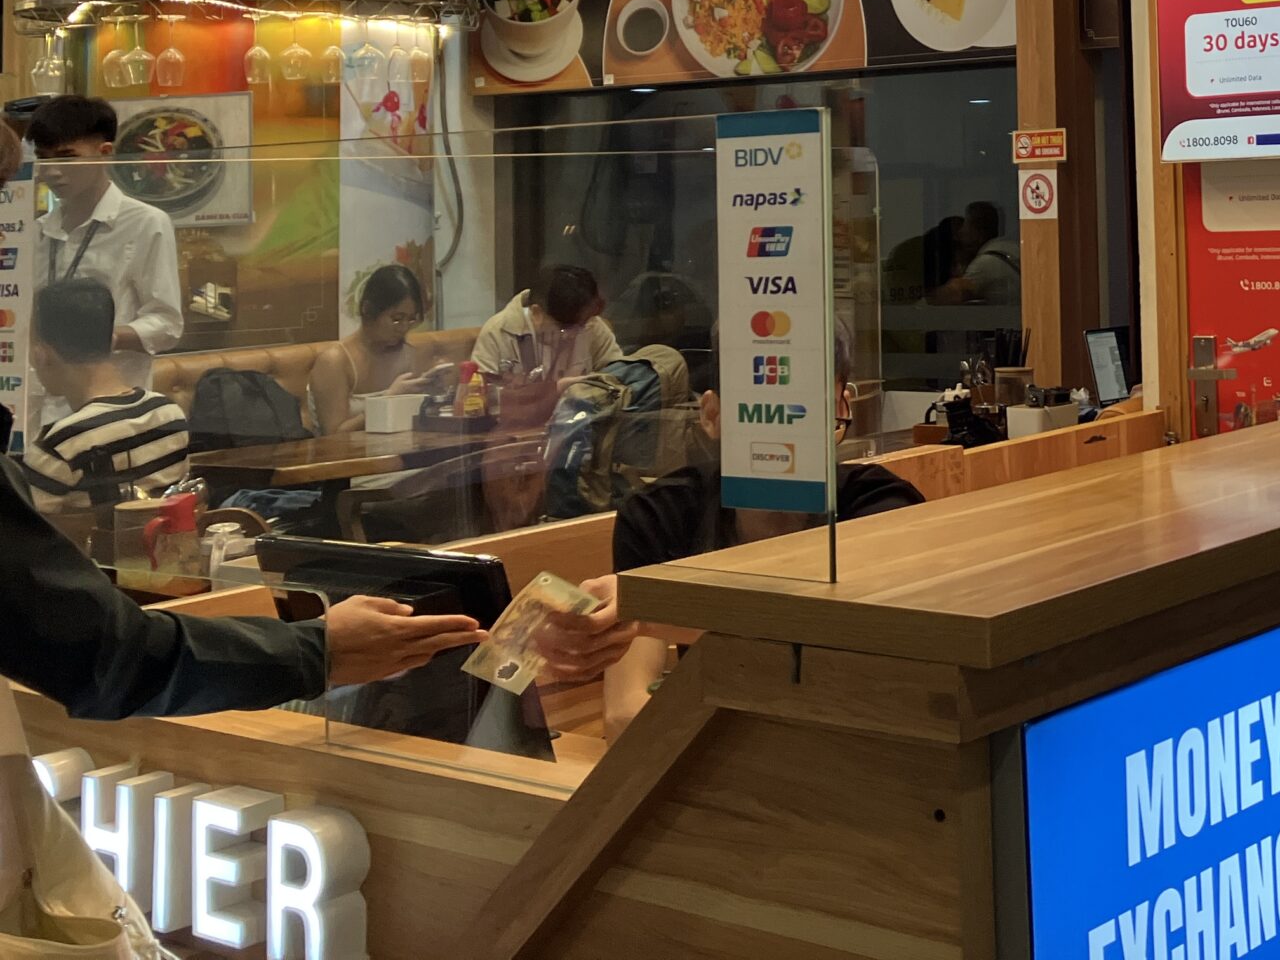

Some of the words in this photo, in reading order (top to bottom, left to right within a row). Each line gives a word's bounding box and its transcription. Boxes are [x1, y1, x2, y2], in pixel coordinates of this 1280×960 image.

[1224, 17, 1257, 28] TOU60
[1203, 33, 1227, 52] 30
[1234, 31, 1279, 53] days
[1248, 73, 1262, 82] Data
[1186, 135, 1238, 148] 1800.8098
[734, 146, 784, 168] BIDV
[732, 190, 788, 210] napas
[744, 276, 797, 295] VISA
[753, 365, 789, 375] JCB
